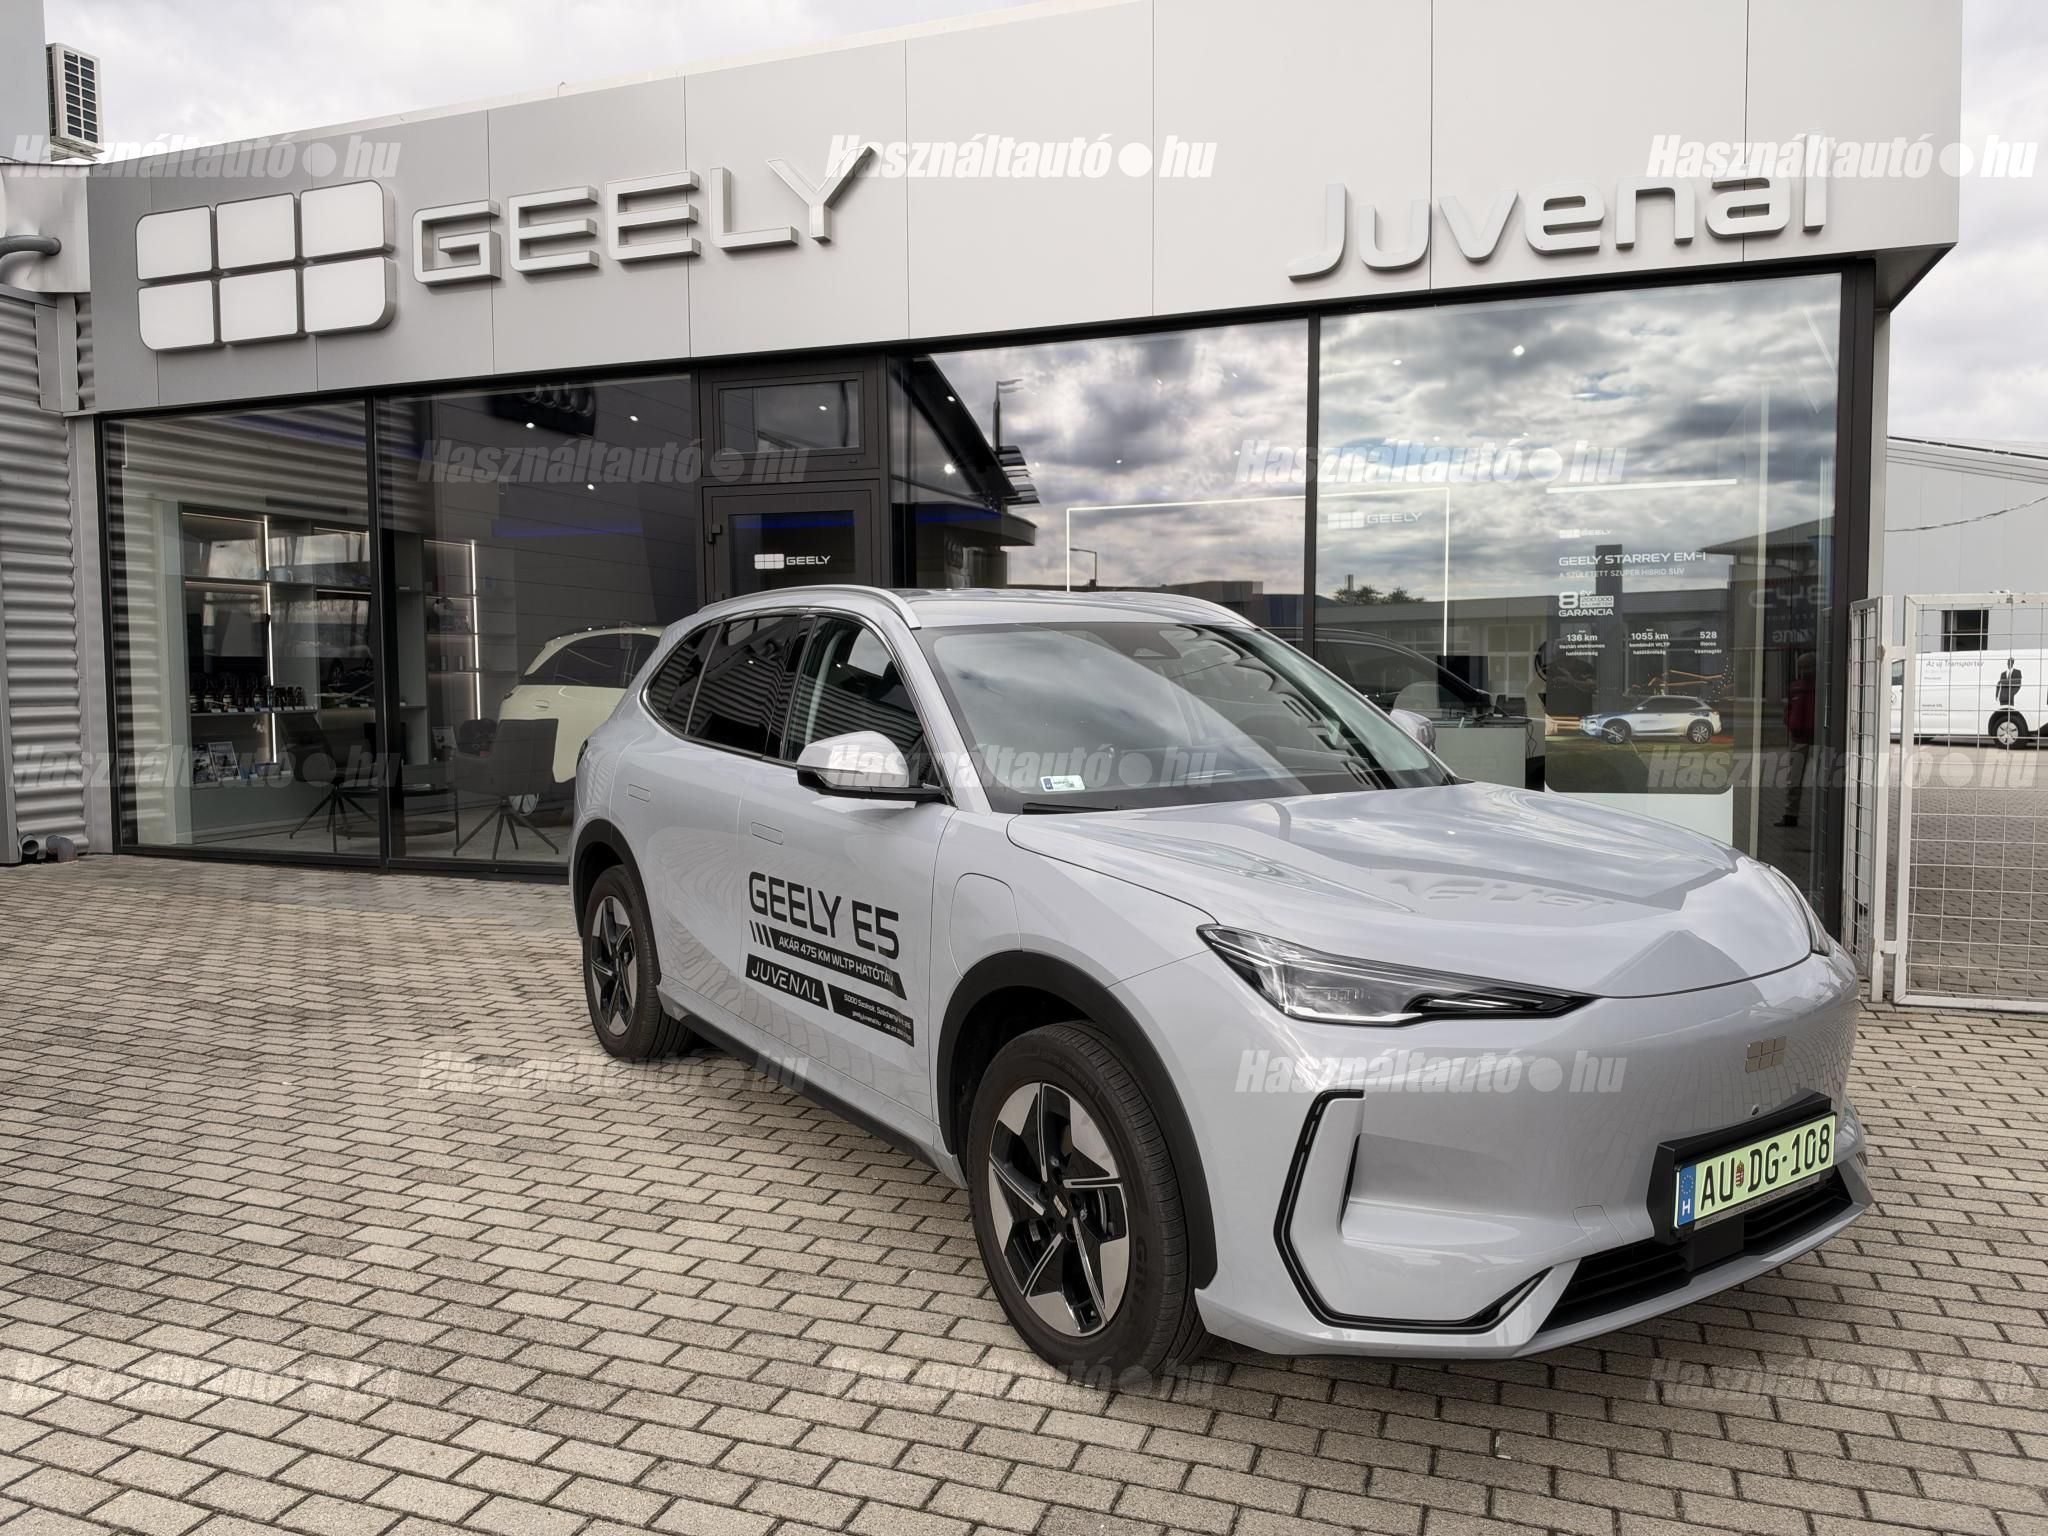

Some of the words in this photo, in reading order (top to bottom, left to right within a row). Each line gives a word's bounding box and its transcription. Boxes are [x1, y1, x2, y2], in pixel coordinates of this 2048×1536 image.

[412, 143, 876, 285] GEELY
[1287, 132, 1829, 282] Juvenal
[1367, 511, 1422, 524] GEELY
[786, 555, 831, 566] GEELY
[1558, 555, 1602, 567] GEELY
[1604, 552, 1671, 565] STARREY
[1610, 568, 1641, 577] SZUPER
[1668, 567, 1685, 576] SUV
[1558, 591, 1579, 609] 8
[1558, 608, 1614, 617] GARANCIA
[1584, 633, 1598, 641] km
[1631, 632, 1653, 640] 1055
[1655, 632, 1669, 640] km
[1700, 631, 1718, 639] 528
[749, 871, 842, 939] GEELY
[852, 899, 900, 960] E5
[778, 936, 800, 953] AKÁR
[801, 944, 817, 958] 475
[817, 948, 832, 964] KM
[832, 954, 855, 971] WLTP
[855, 961, 895, 988] HATÓTÁV
[751, 961, 821, 1002] JUVENAL
[1700, 1157, 1735, 1212] AU
[1747, 1123, 1830, 1193] DG-108
[1681, 1198, 1691, 1217] H
